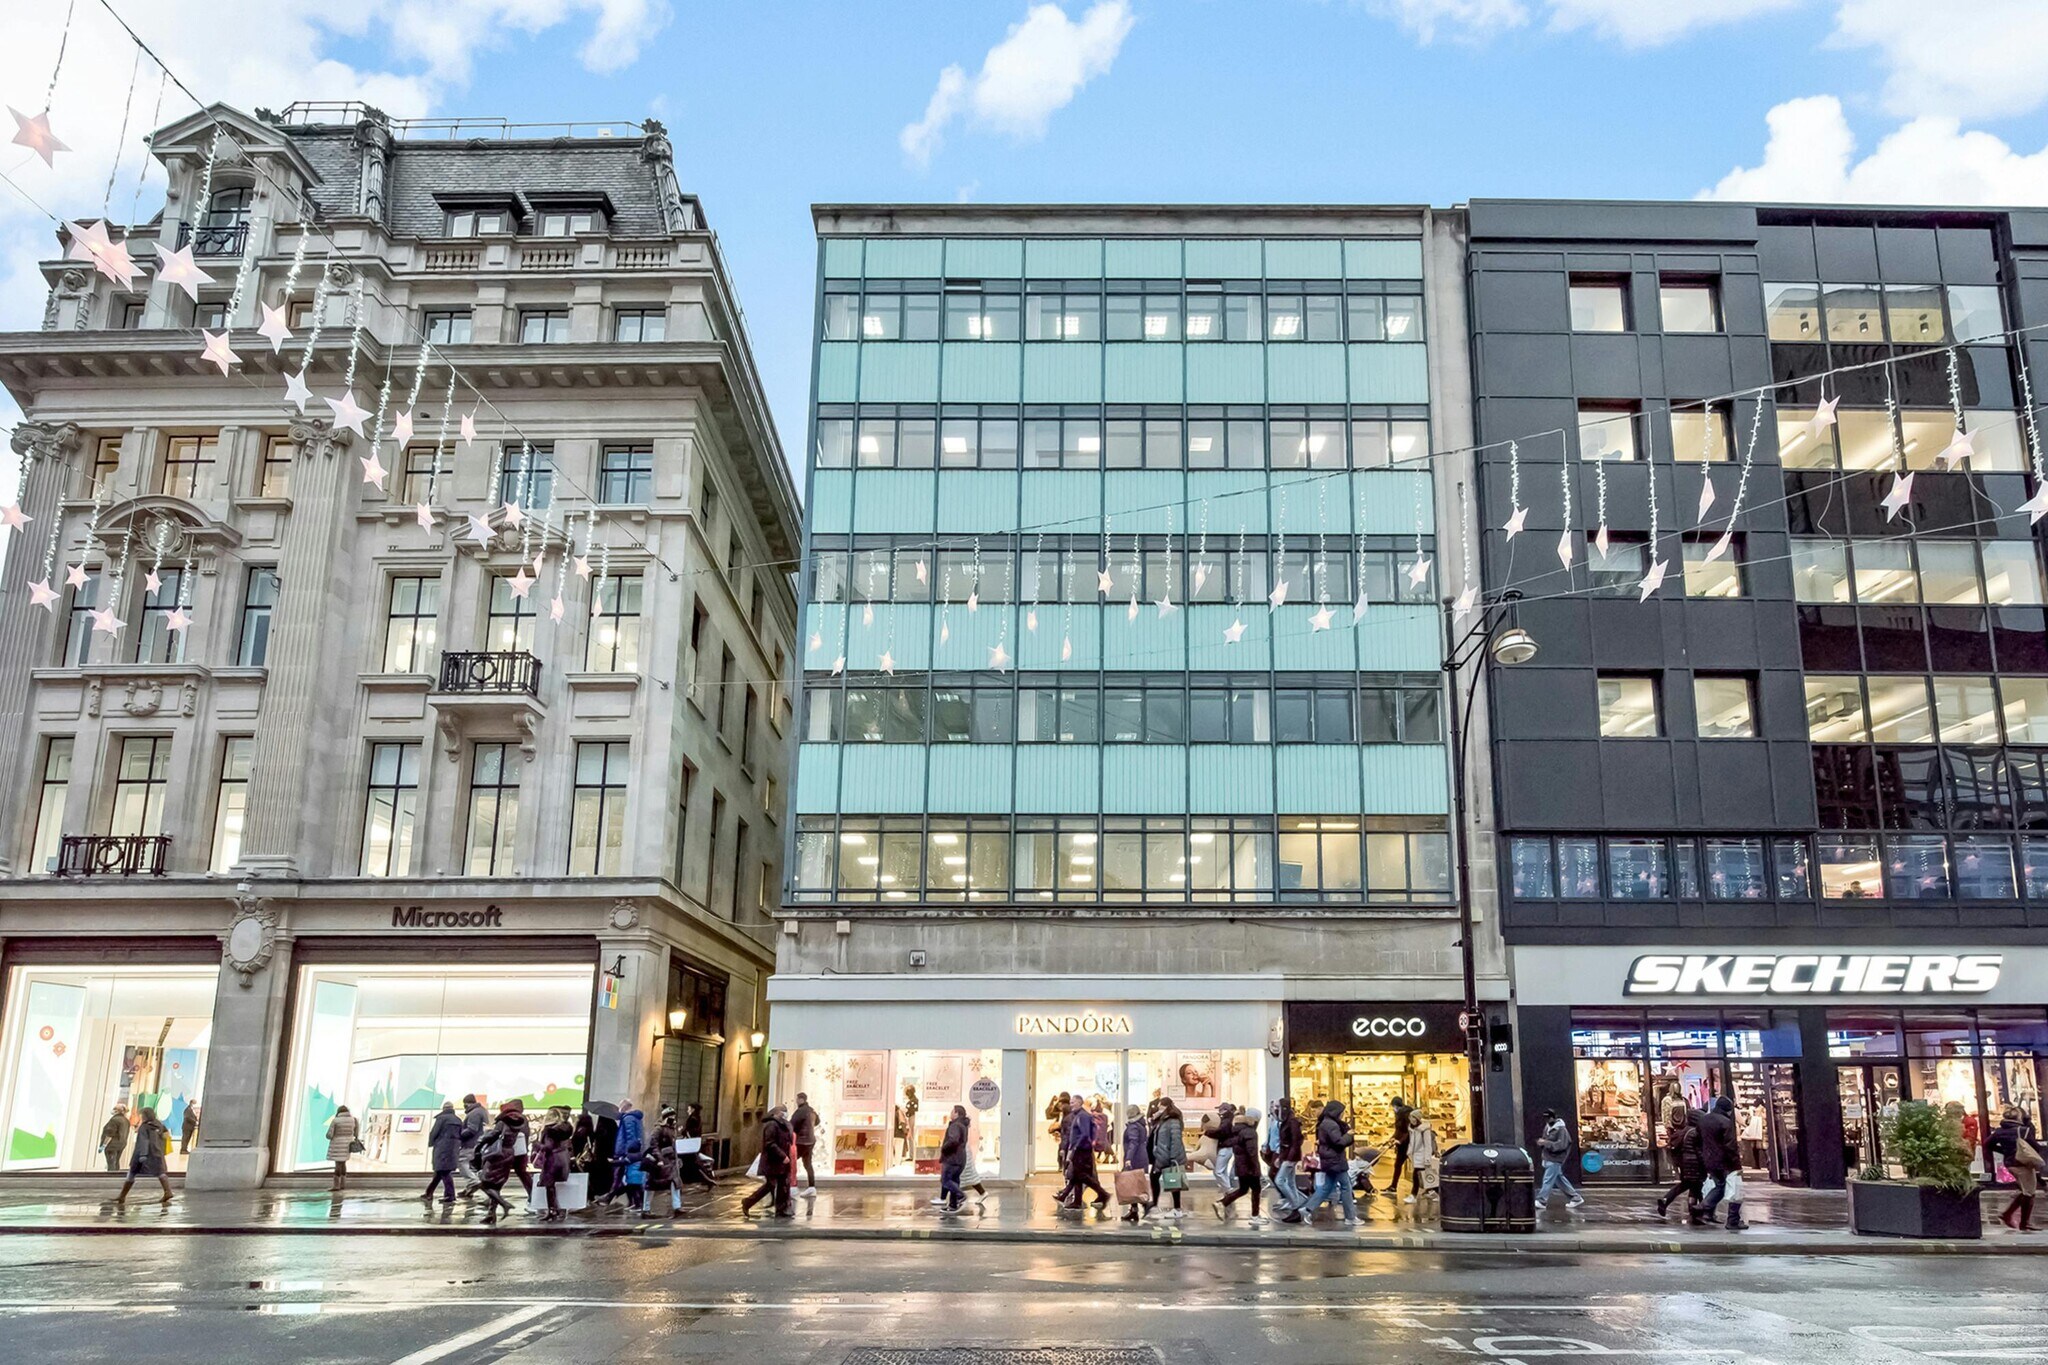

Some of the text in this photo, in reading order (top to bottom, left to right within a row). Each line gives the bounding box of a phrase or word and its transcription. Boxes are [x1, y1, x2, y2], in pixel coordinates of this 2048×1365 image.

[391, 904, 503, 928] Microsoft
[1625, 955, 2003, 994] SKECHERS
[1018, 1014, 1130, 1033] PANDORA
[1352, 1017, 1426, 1037] ecco
